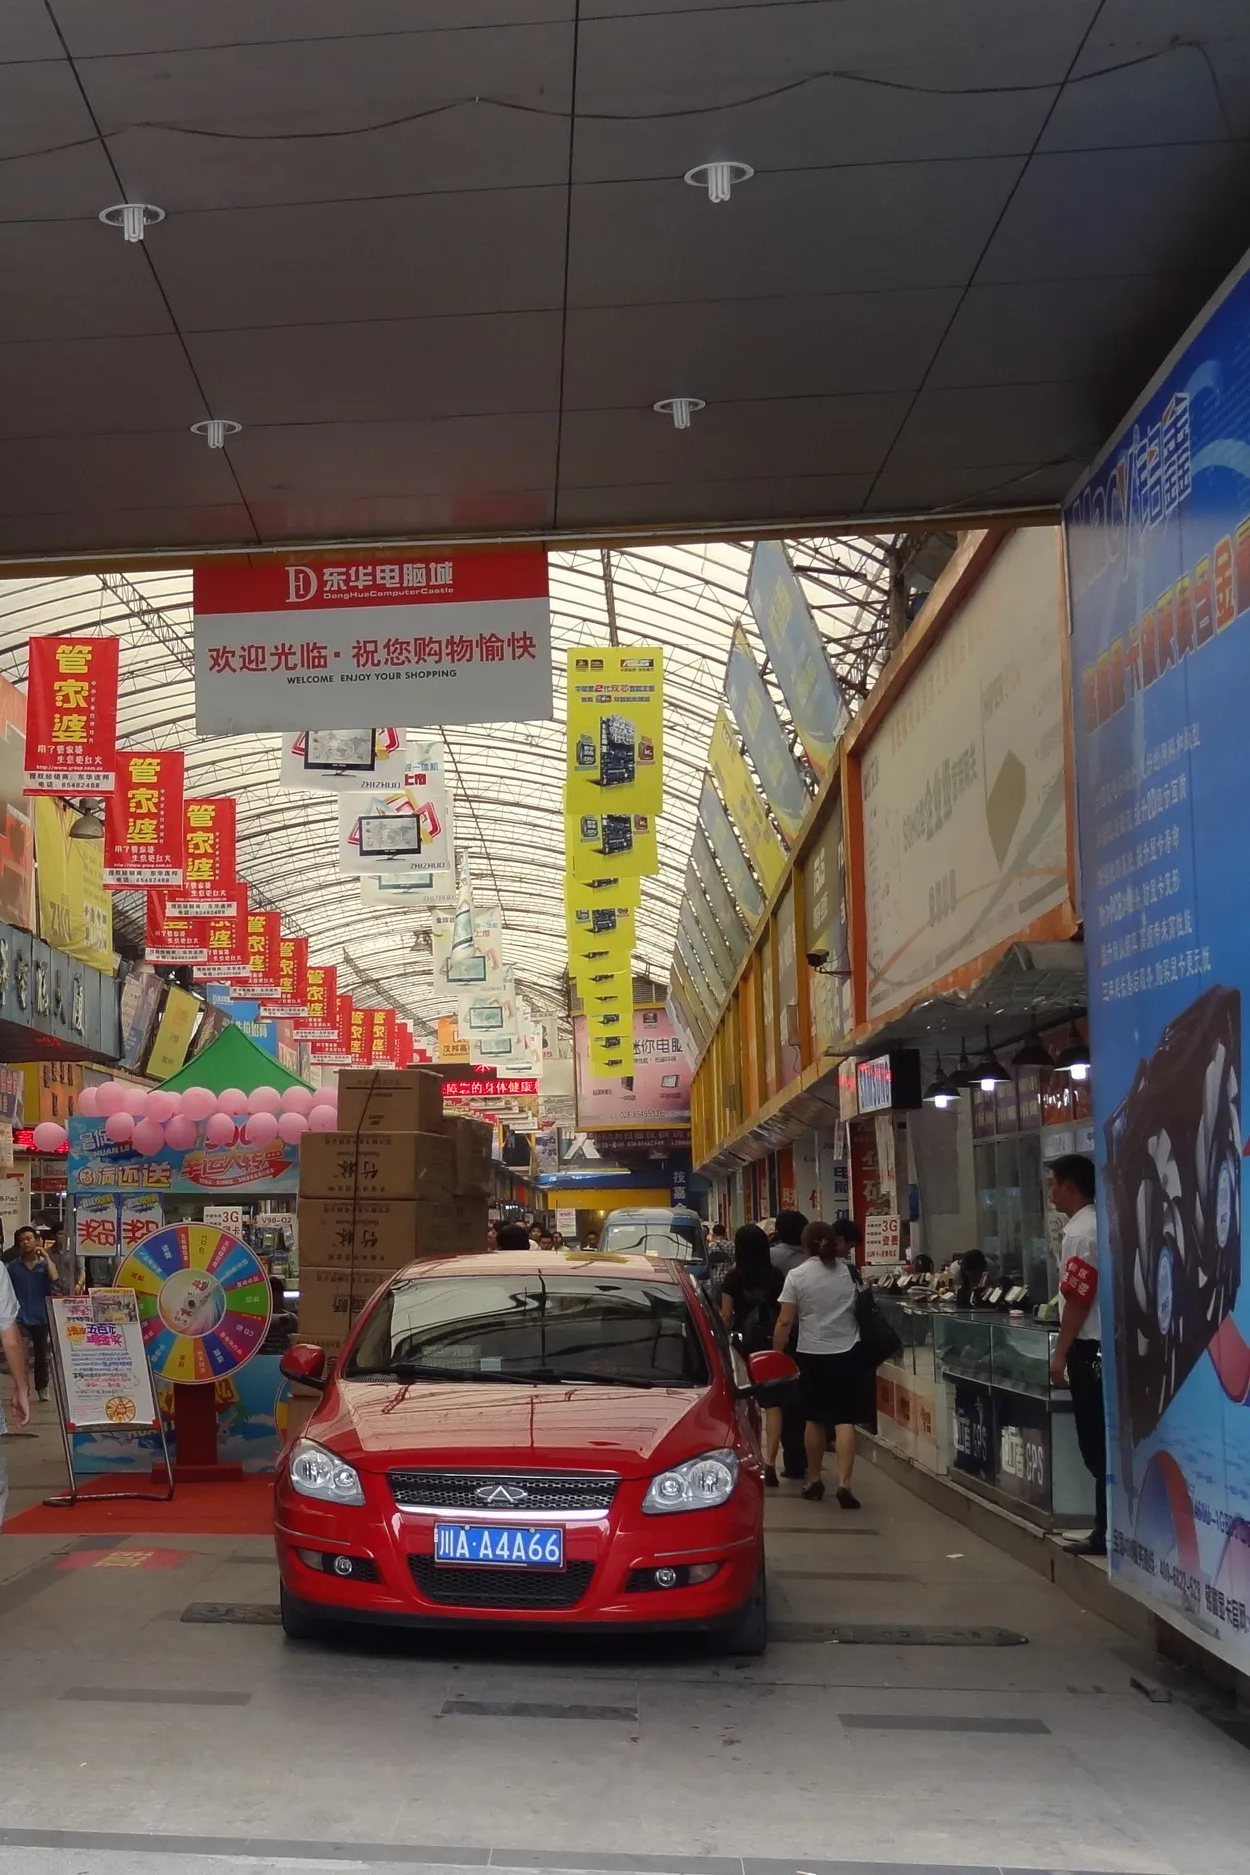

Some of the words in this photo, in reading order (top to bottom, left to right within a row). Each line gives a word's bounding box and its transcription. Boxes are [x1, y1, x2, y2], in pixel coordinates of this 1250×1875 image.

[323, 562, 453, 591] 东华电脑城
[323, 587, 454, 600] DongHuaComputerCastle
[208, 631, 537, 673] 欢迎光临·祝您购物愉快
[52, 644, 92, 743] 管家婆
[287, 675, 334, 685] WELCOME
[340, 674, 371, 684] ENJOY
[374, 673, 402, 683] YOUR
[405, 670, 457, 680] SHOPPING
[37, 745, 83, 754] 用了管家婆
[57, 755, 103, 765] 生意更红火
[126, 757, 161, 844] 管家婆
[186, 804, 216, 880] 管家婆
[247, 916, 266, 972] 管家婆
[279, 941, 295, 993] 管家婆
[306, 969, 325, 1017] 管家婆
[442, 1081, 539, 1095] 障您的身体健康
[222, 1211, 239, 1223] 3G
[882, 1219, 898, 1232] 3G
[1026, 1442, 1044, 1486] GPS
